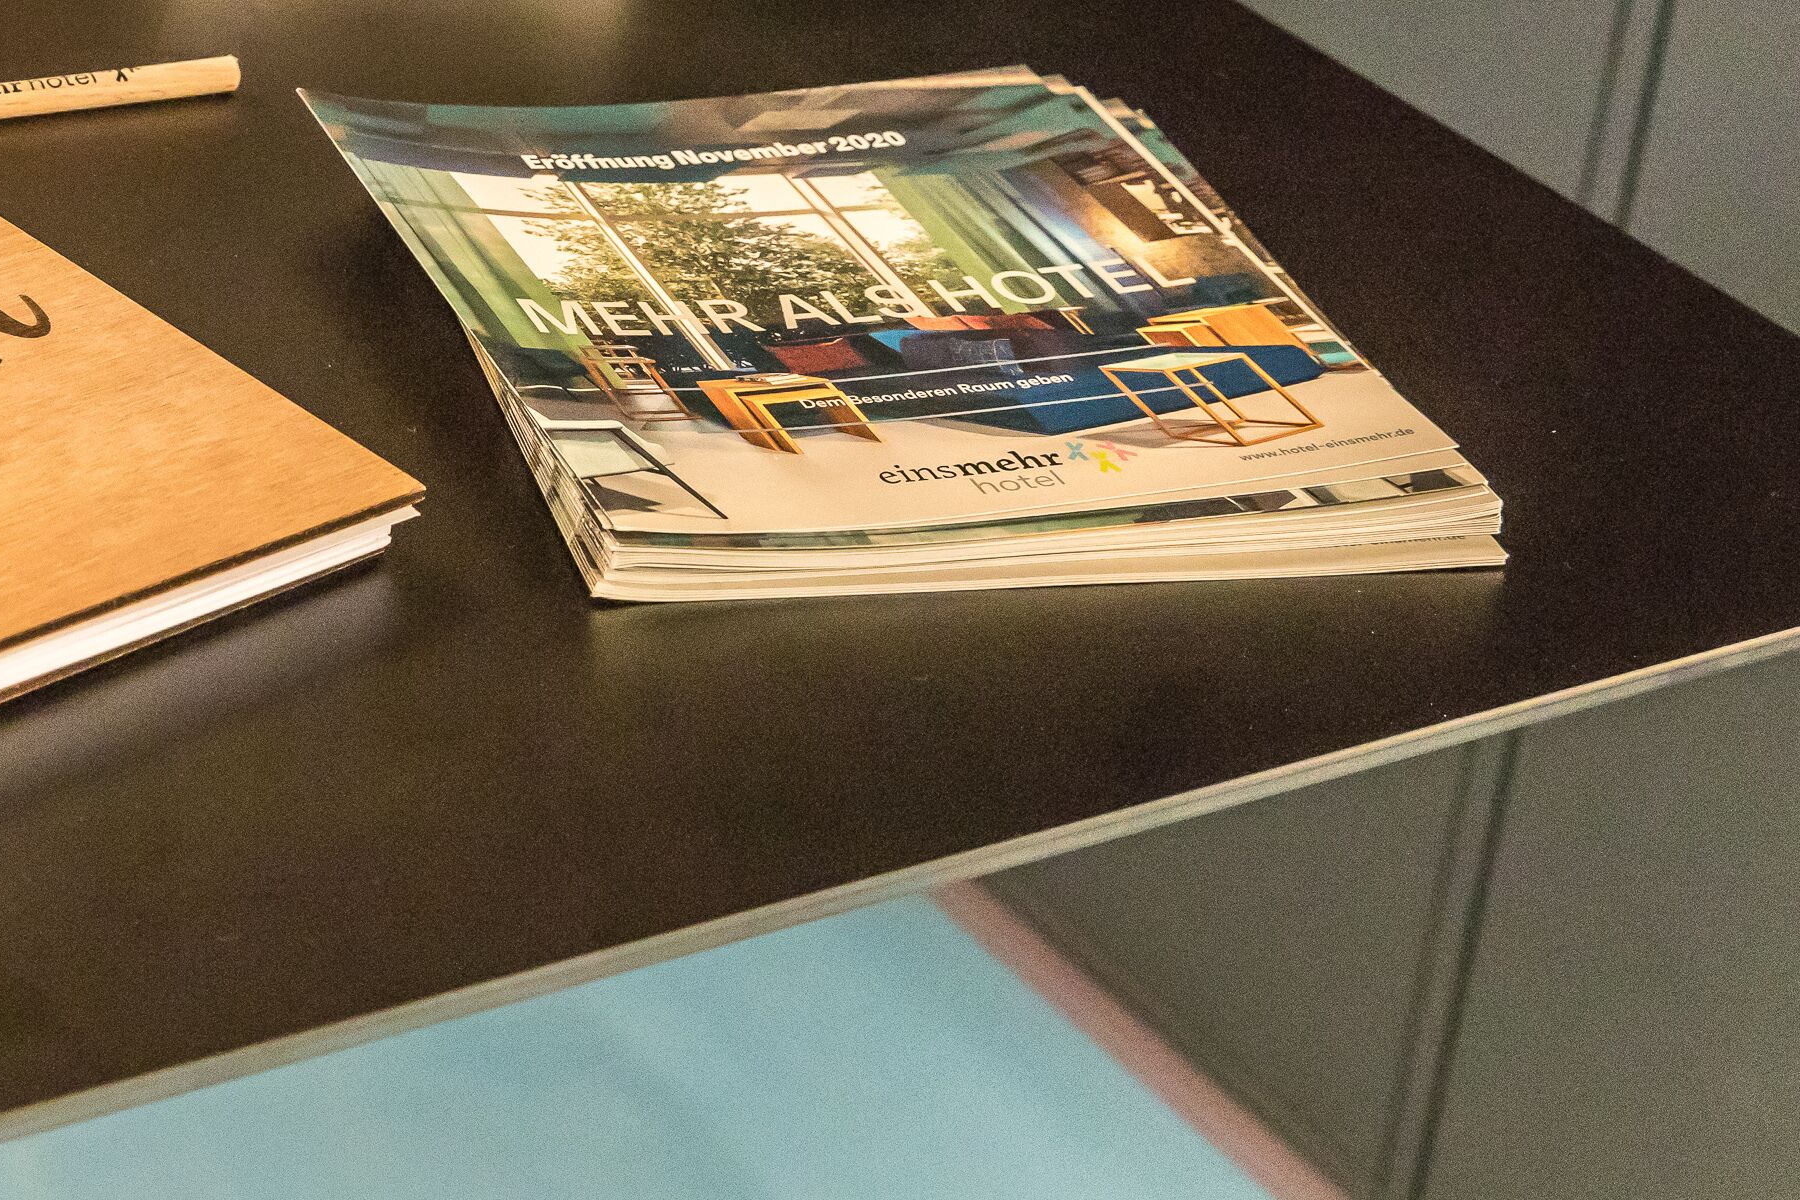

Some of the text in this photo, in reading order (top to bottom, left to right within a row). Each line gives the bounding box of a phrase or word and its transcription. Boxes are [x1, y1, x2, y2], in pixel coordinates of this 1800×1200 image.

[520, 129, 907, 171] Eröffnung November 2020
[515, 256, 1198, 339] MEHR ALS HOTEL
[799, 371, 1075, 411] Dem Besonderen Raum geben
[1238, 426, 1416, 462] www.hotel-einsmehr.de
[878, 449, 1065, 486] einsmehr
[968, 468, 1067, 496] hotel
